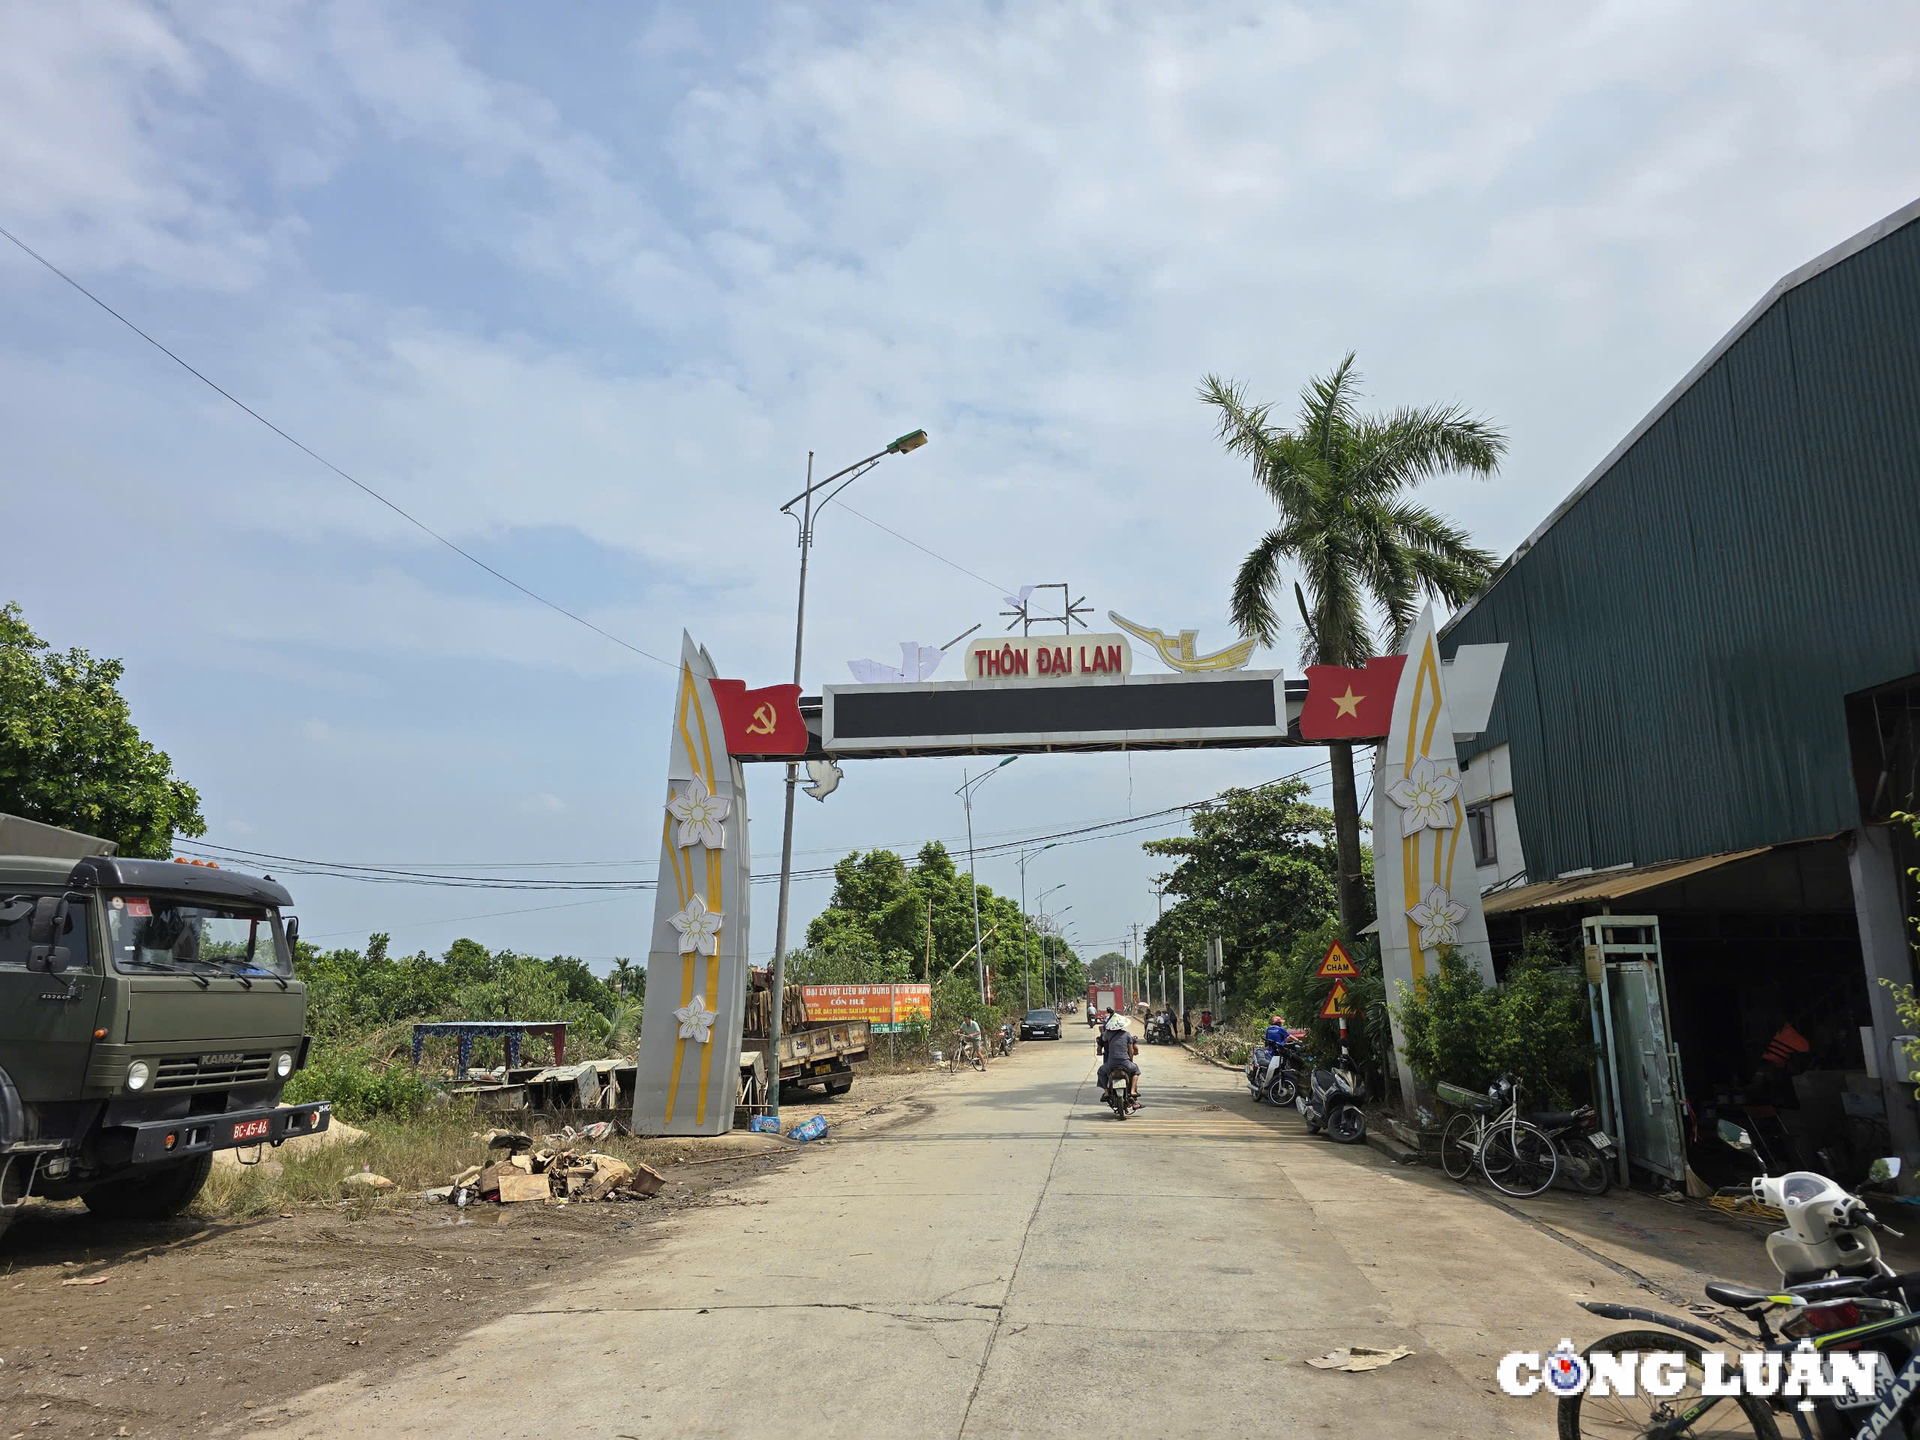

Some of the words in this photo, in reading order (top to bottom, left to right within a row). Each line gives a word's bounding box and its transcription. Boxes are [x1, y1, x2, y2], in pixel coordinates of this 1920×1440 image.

[975, 643, 1028, 676] THÔN
[1036, 646, 1072, 677] ĐẠI
[1080, 645, 1122, 673] LAN
[1333, 954, 1341, 962] ĐI
[201, 1053, 244, 1065] KAMAZ
[233, 1120, 267, 1139] BC-45-46
[1856, 1355, 1920, 1440] GALAX
